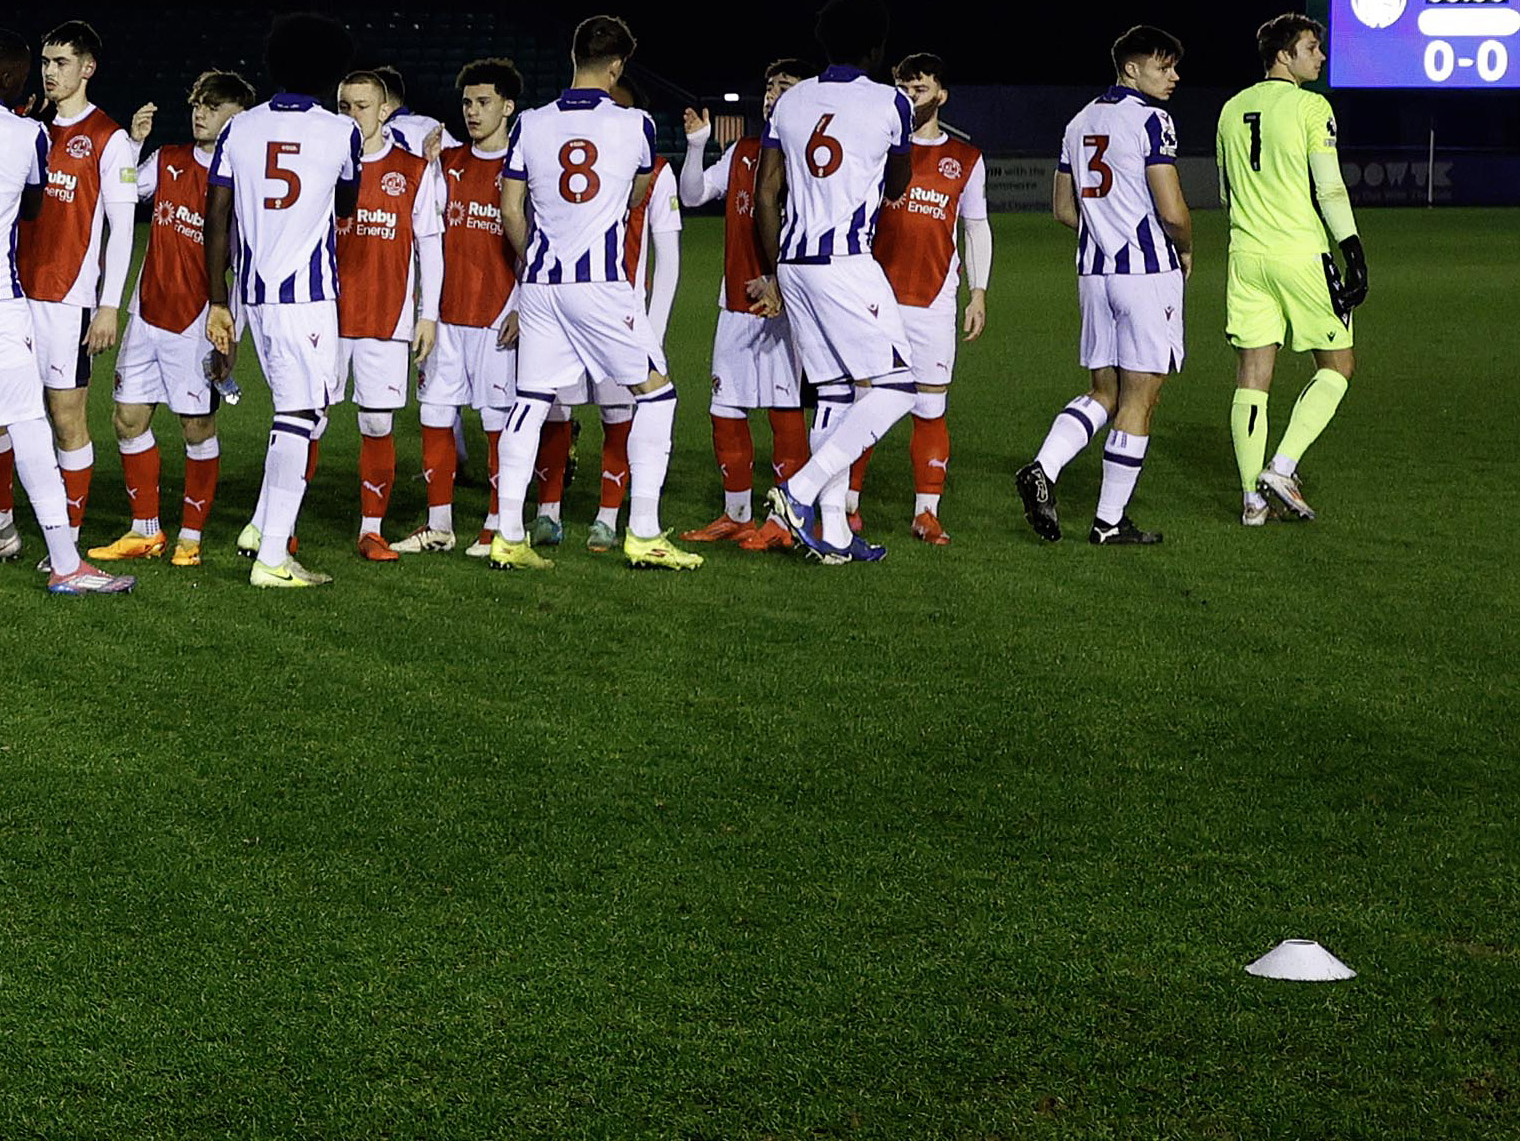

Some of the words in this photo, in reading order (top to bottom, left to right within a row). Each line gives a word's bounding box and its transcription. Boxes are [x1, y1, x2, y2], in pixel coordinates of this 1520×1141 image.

[1424, 39, 1508, 83] 0-0
[805, 113, 844, 178] 6
[1243, 112, 1261, 171] 1
[264, 141, 301, 209] 5
[558, 138, 601, 204] 8
[1081, 135, 1113, 198] 3
[45, 167, 77, 190] uby
[45, 187, 75, 203] ergy
[910, 187, 950, 208] Ruby
[176, 206, 205, 228] Rub
[357, 209, 397, 227] Ruby
[908, 201, 947, 220] Energy
[356, 224, 396, 239] Energy
[466, 216, 504, 236] Energy
